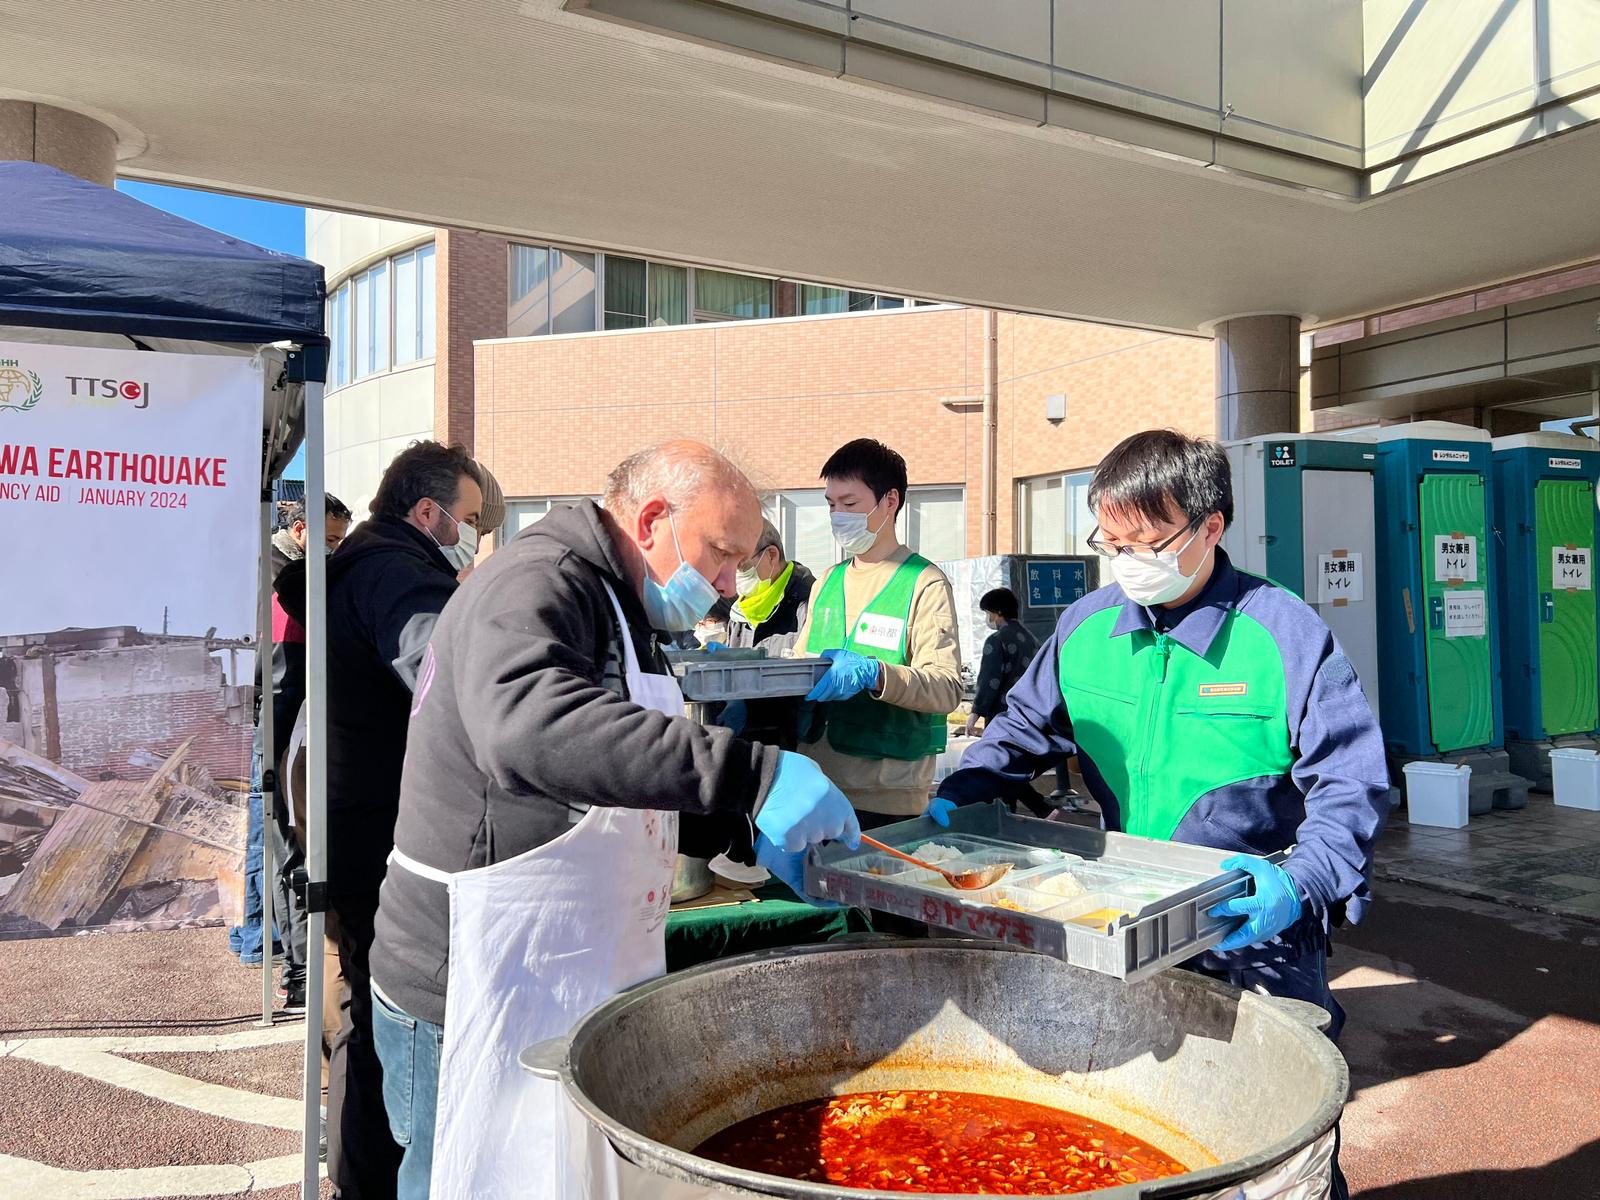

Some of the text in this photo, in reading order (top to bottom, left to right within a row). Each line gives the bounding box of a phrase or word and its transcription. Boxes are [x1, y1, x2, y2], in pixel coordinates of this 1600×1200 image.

[0, 359, 19, 367] HH
[48, 448, 227, 487] EARTHQUAKE
[35, 485, 60, 502] AID
[78, 487, 146, 507] JANUARY
[150, 491, 188, 509] 2024
[1441, 542, 1470, 554] 男女兼用
[1446, 558, 1467, 569] トイレ
[1558, 553, 1585, 565] 男女兼用
[1324, 560, 1355, 573] 男女兼用
[1562, 568, 1582, 578] トイレ
[1328, 577, 1351, 590] トイレ
[943, 901, 1035, 945] ヤマザキ
